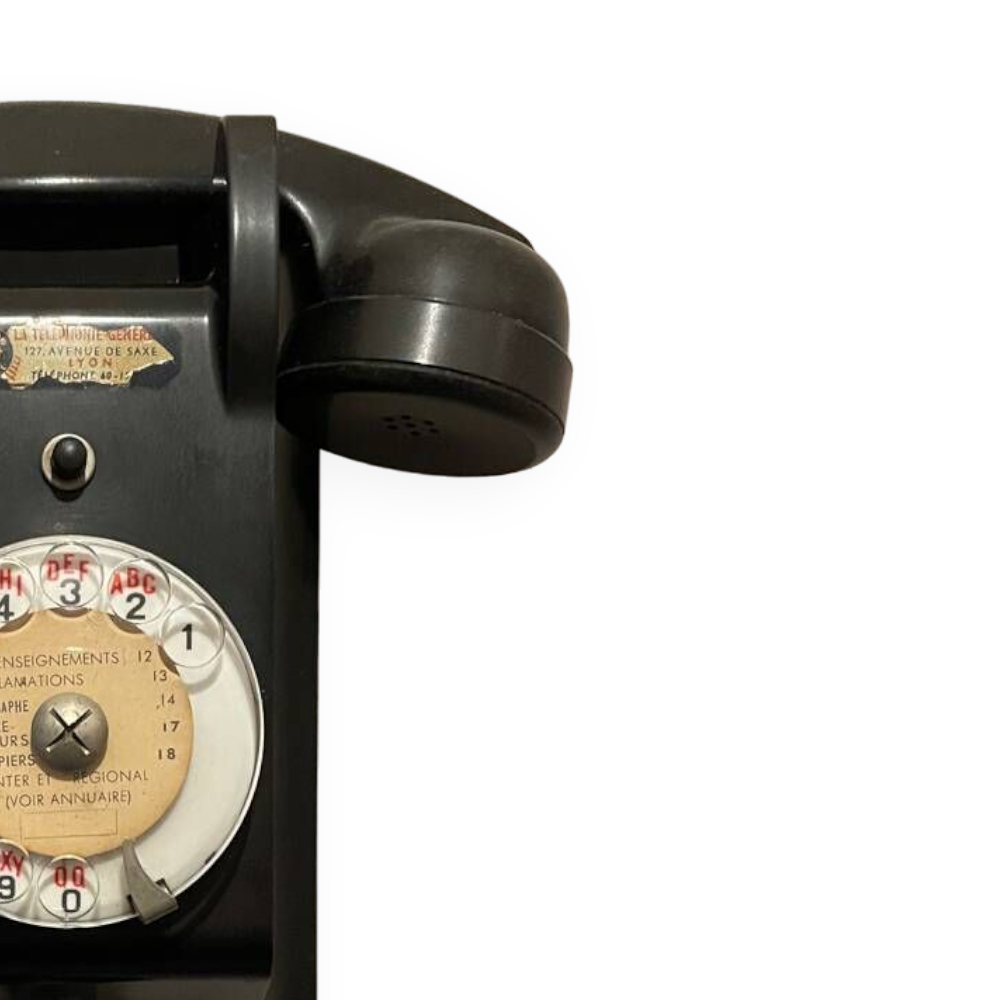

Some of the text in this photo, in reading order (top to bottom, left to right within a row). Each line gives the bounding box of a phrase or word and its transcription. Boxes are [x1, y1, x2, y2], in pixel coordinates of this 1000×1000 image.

[48, 346, 100, 357] AVENUE
[106, 346, 121, 357] DE
[127, 346, 158, 358] SAXE
[69, 357, 113, 368] LYON
[47, 553, 90, 582] DEF
[110, 567, 156, 595] ABC
[60, 578, 81, 606] 3
[126, 592, 147, 620] 2
[181, 624, 193, 650] 1
[137, 650, 153, 663] 12
[153, 670, 168, 682] 13
[161, 693, 176, 706] 14
[163, 720, 181, 733] 17
[157, 747, 177, 761] 18
[37, 772, 52, 786] ET
[5, 790, 132, 810] (VOIR ANNUAIRE)
